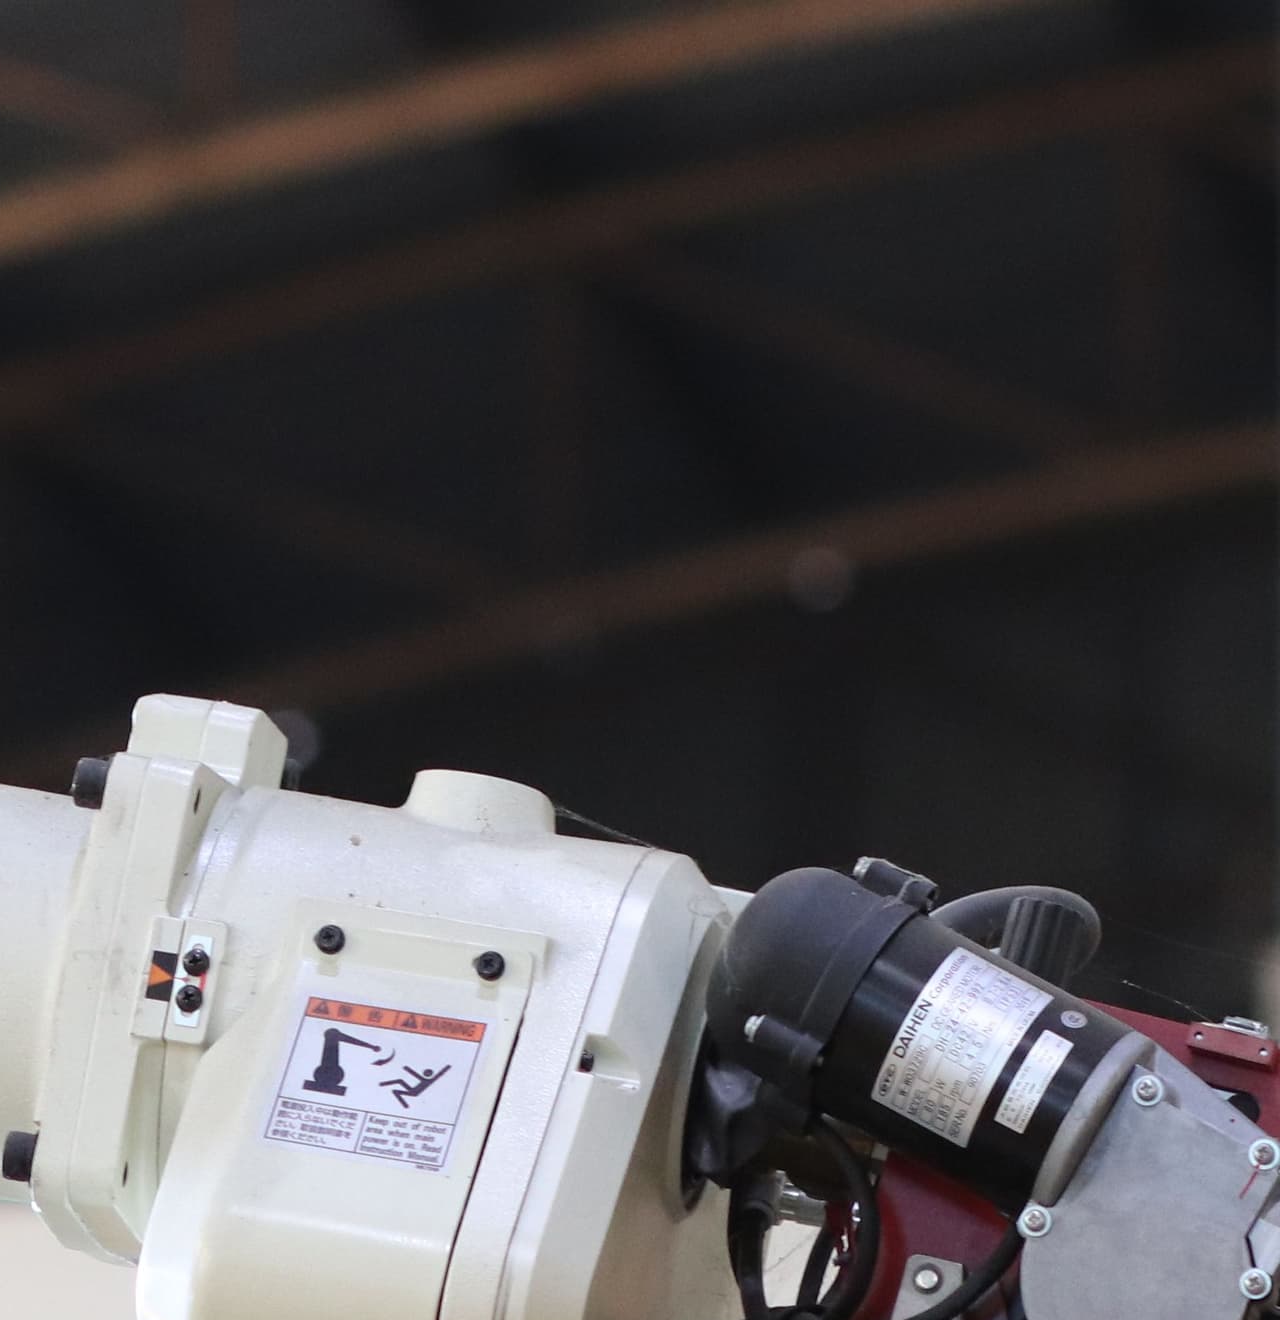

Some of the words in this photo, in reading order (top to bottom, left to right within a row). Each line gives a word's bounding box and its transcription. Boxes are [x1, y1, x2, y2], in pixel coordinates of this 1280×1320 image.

[892, 998, 933, 1059] DAIHEN
[927, 952, 968, 999] Corporation
[368, 1115, 389, 1126] Keep
[392, 1120, 407, 1128] out
[411, 1122, 422, 1130] of
[423, 1124, 446, 1134] robot
[365, 1126, 382, 1134] area
[387, 1129, 409, 1138] when
[414, 1133, 435, 1142] main
[362, 1136, 388, 1144] power
[421, 1143, 441, 1153] Read
